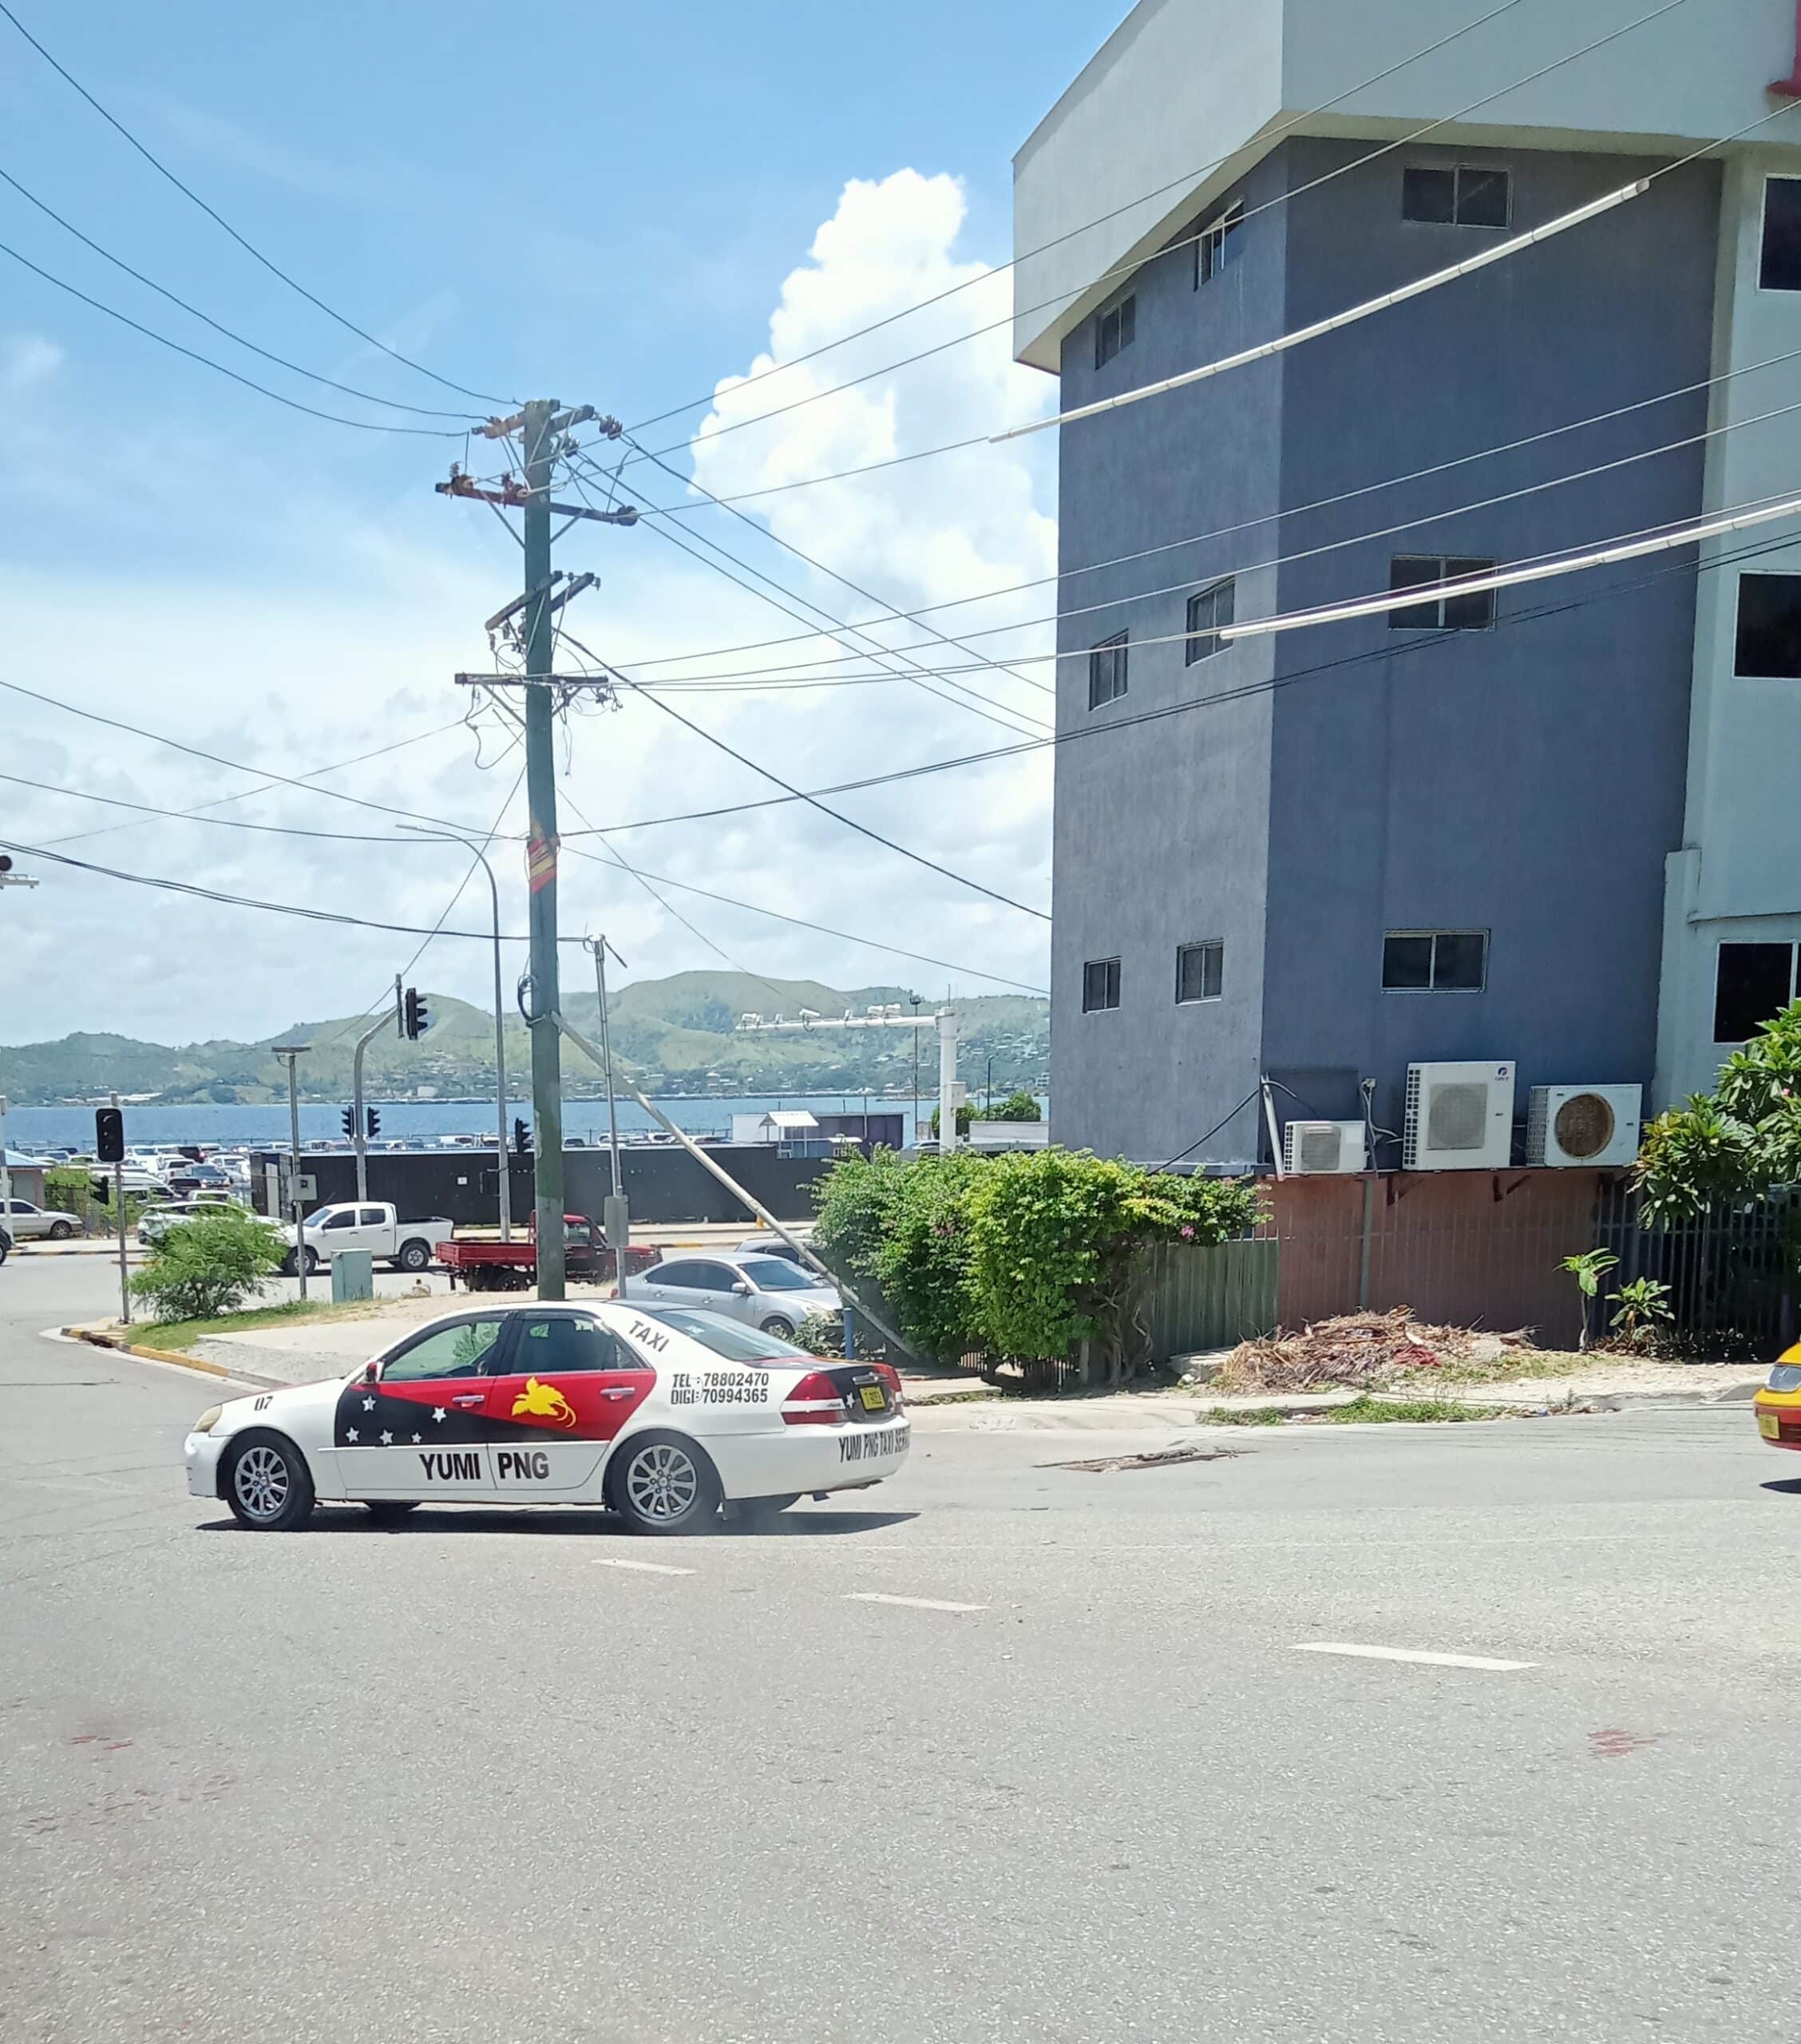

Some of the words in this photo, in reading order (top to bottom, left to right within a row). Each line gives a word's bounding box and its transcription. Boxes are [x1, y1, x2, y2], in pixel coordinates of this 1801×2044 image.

[629, 1320, 670, 1352] TAXI
[254, 1396, 273, 1411] 07
[838, 1434, 861, 1463] YUMI
[863, 1432, 878, 1459] PNG
[419, 1453, 481, 1480] YUMI
[497, 1452, 549, 1479] PNG
